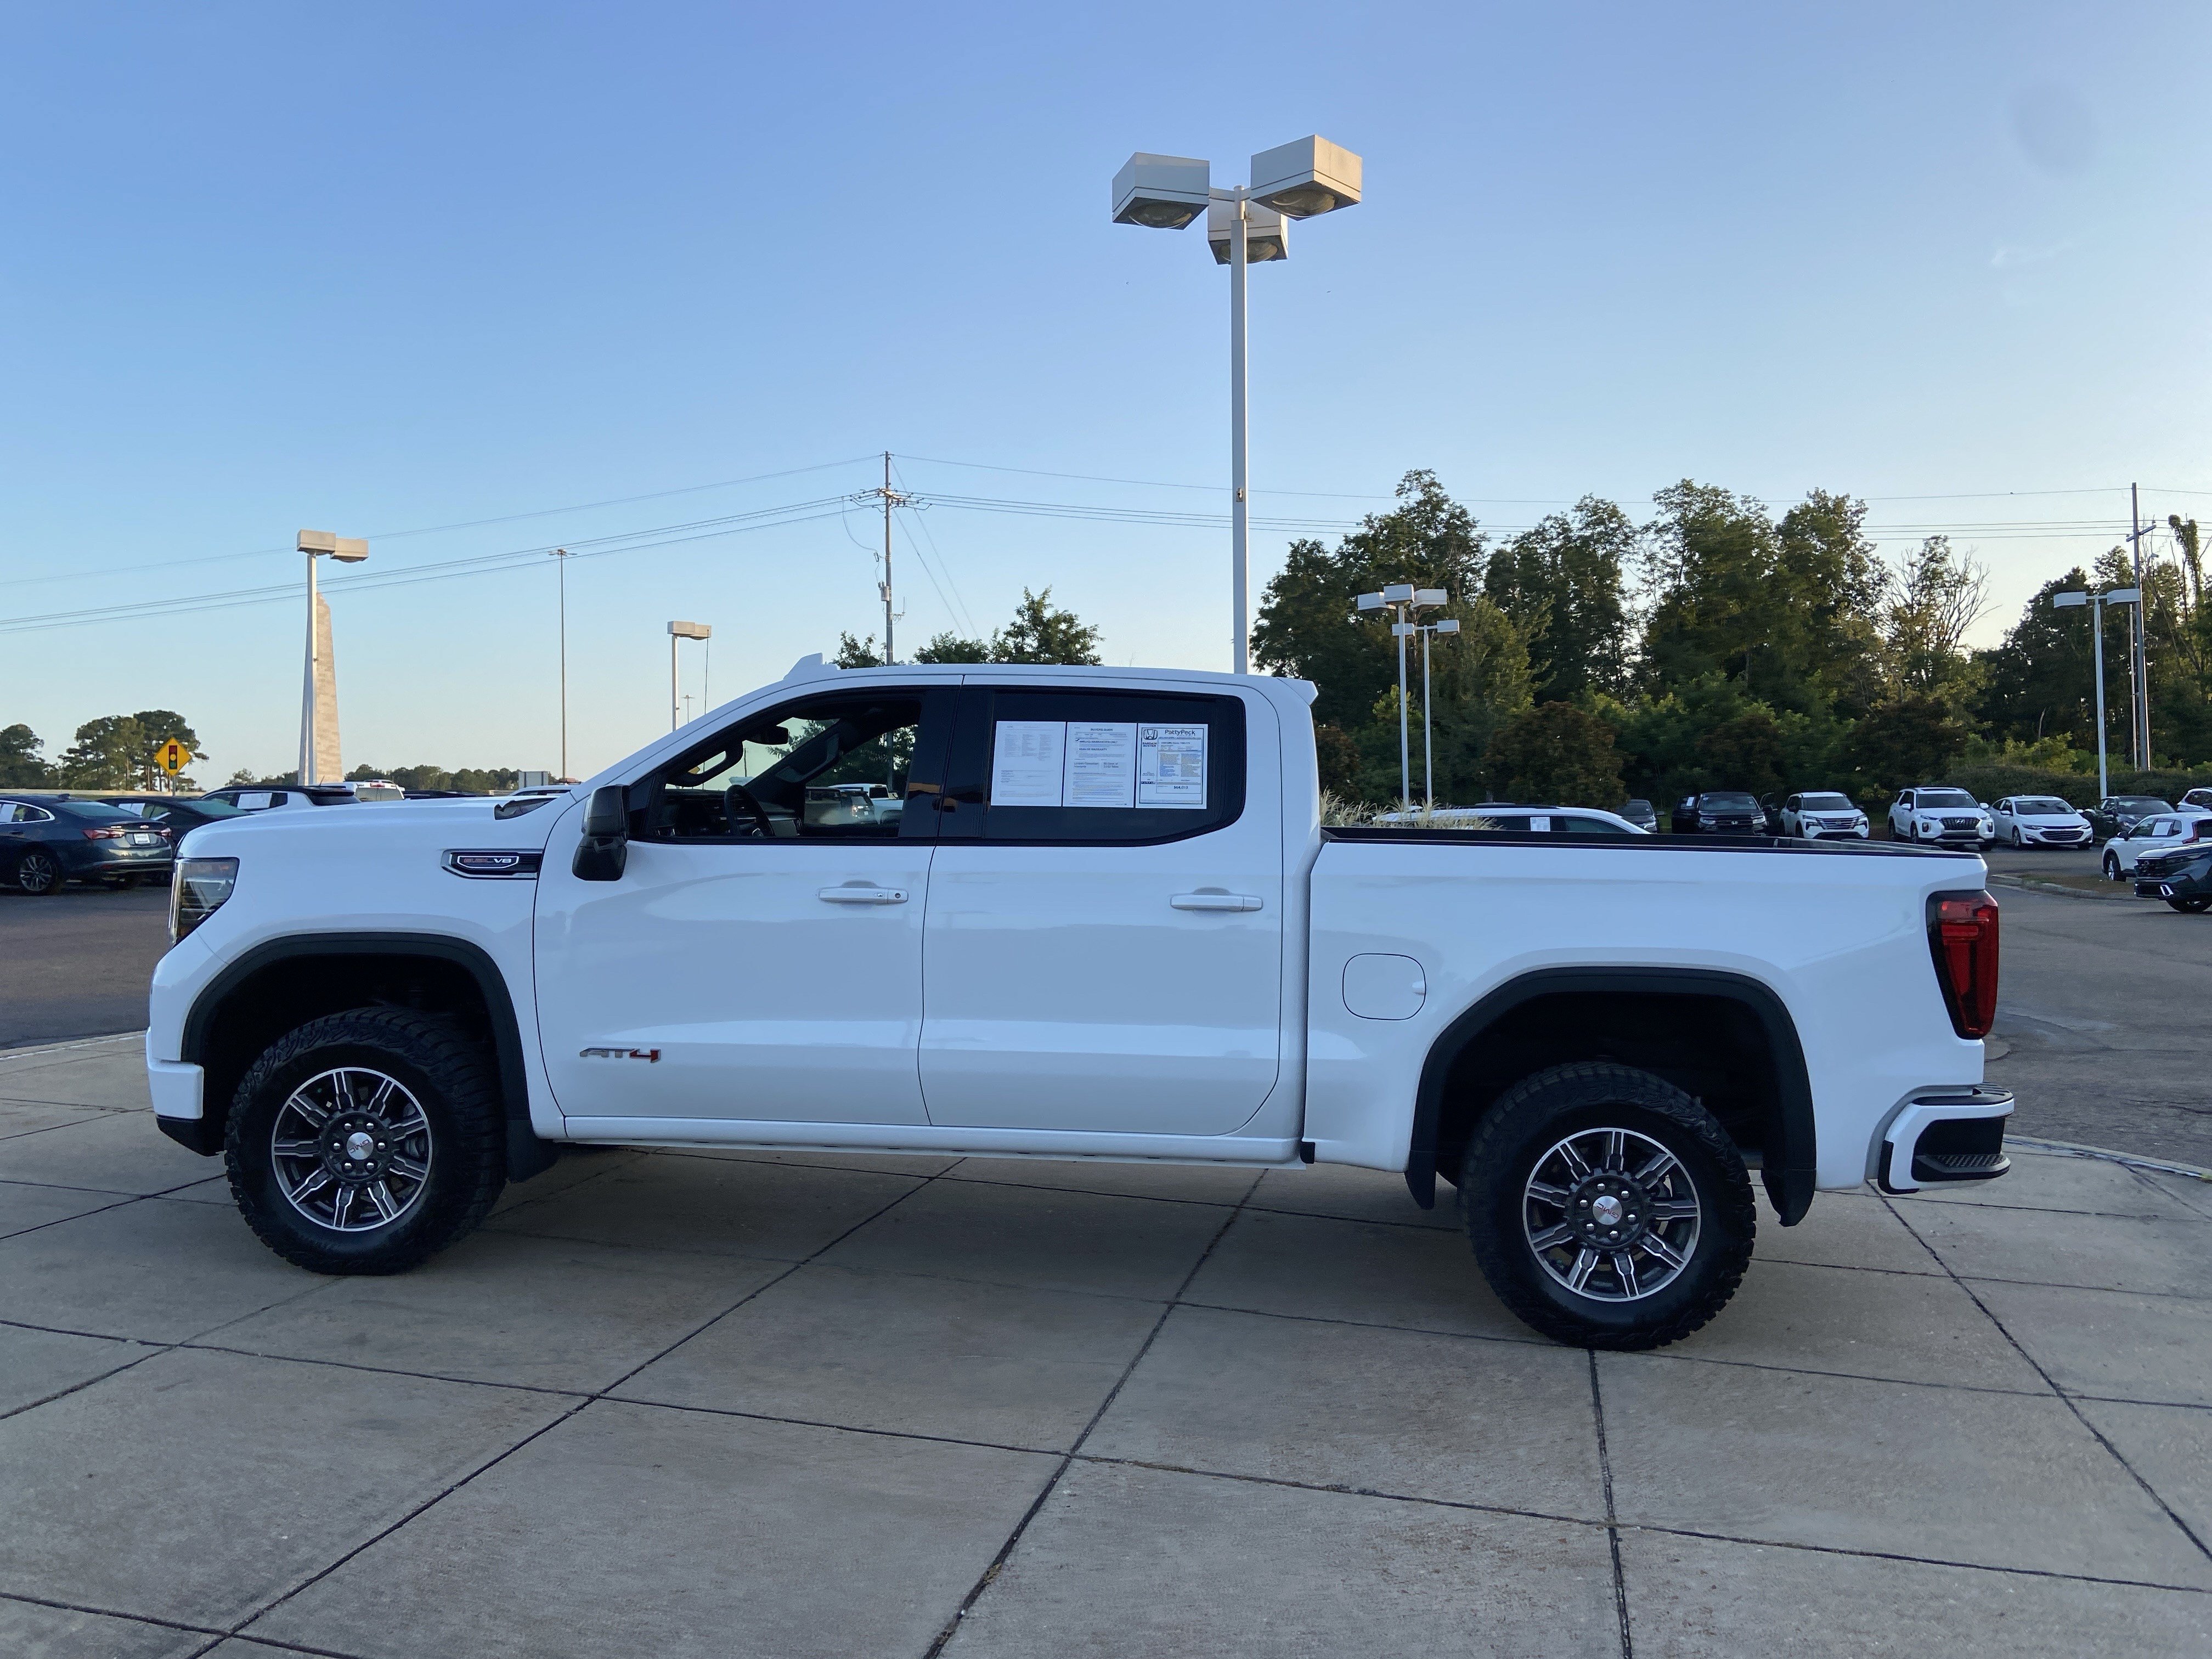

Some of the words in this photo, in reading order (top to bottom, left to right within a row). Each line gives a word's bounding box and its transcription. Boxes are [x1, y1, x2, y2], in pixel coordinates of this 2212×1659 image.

[579, 1046, 661, 1063] AT4
[349, 1139, 371, 1154] GMC
[1595, 1202, 1621, 1220] GMC
